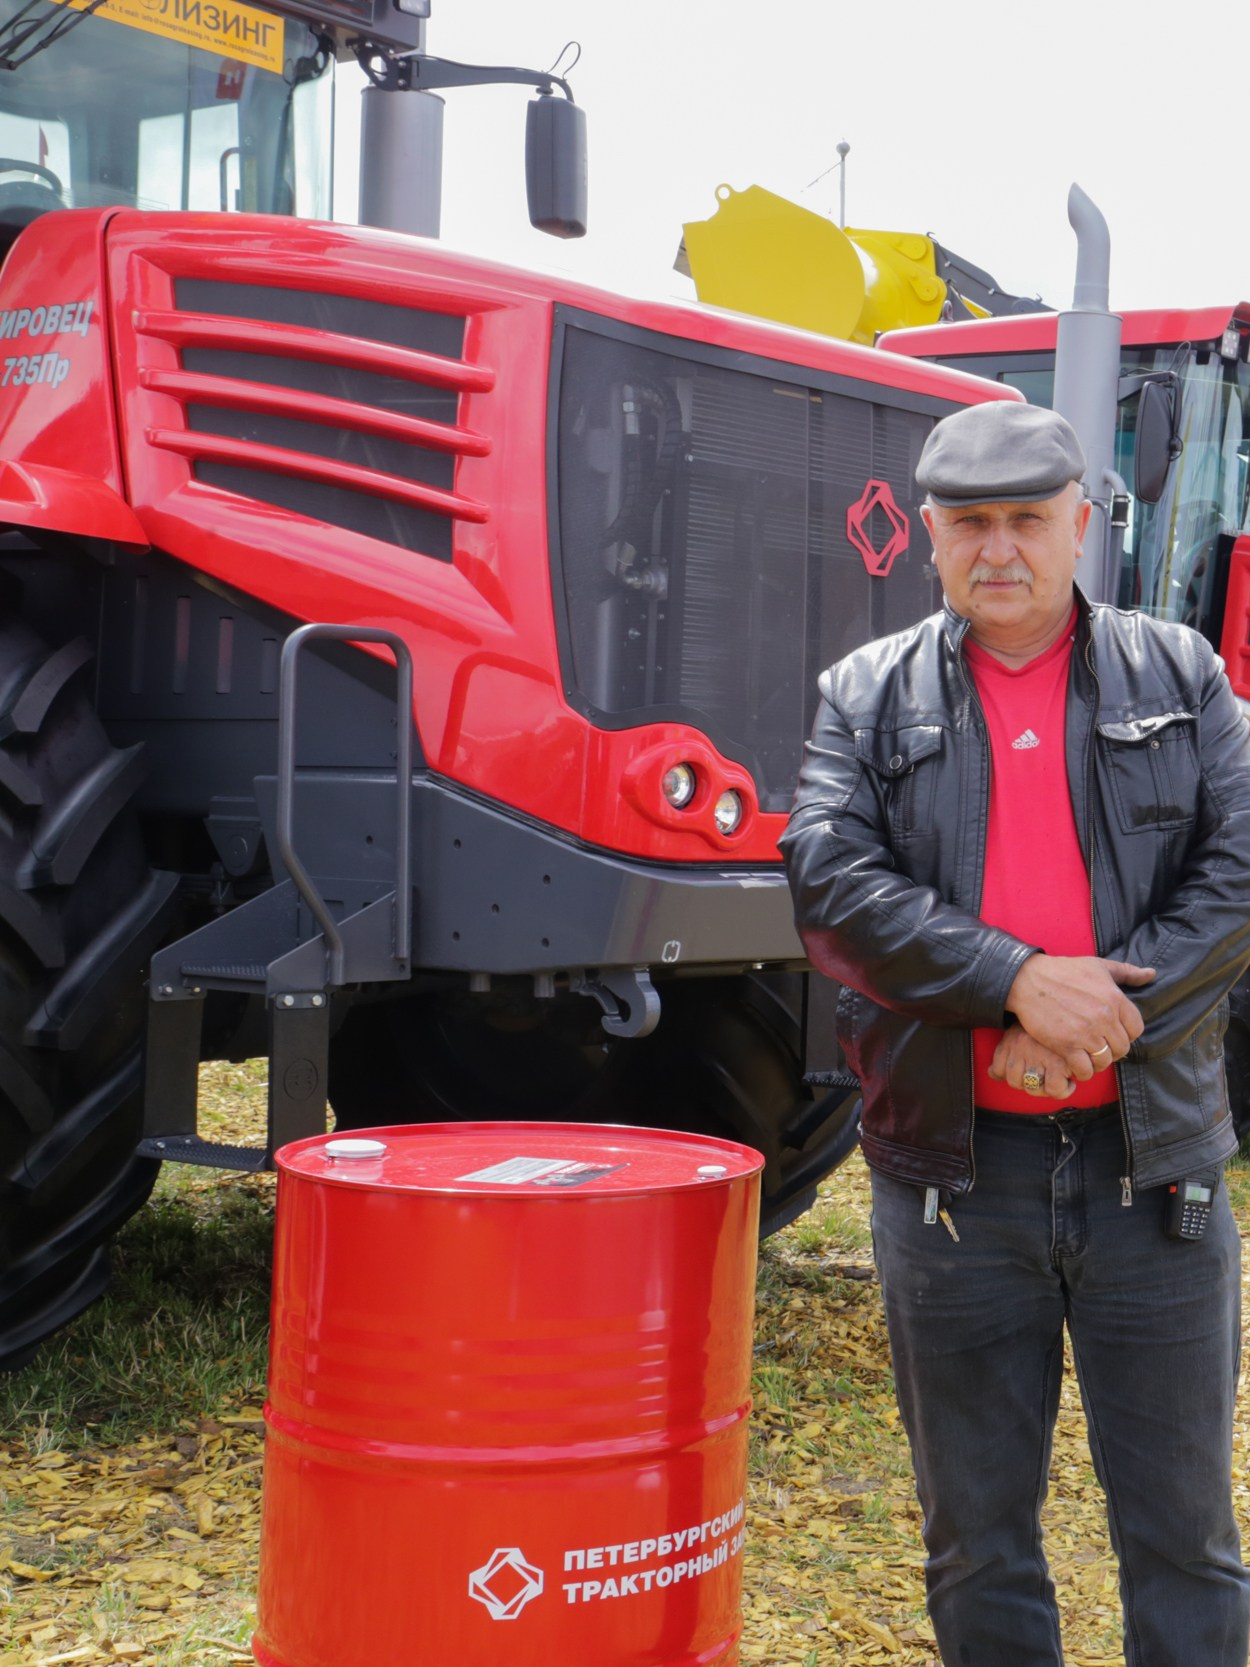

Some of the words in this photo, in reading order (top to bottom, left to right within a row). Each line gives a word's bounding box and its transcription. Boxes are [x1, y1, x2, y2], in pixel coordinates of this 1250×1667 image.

[0, 300, 93, 339] ИРОВЕЦ
[563, 1497, 744, 1571] ПЕТЕРБУРГСКИЙ
[562, 1539, 728, 1604] ТРАКТОРНЫЙ
